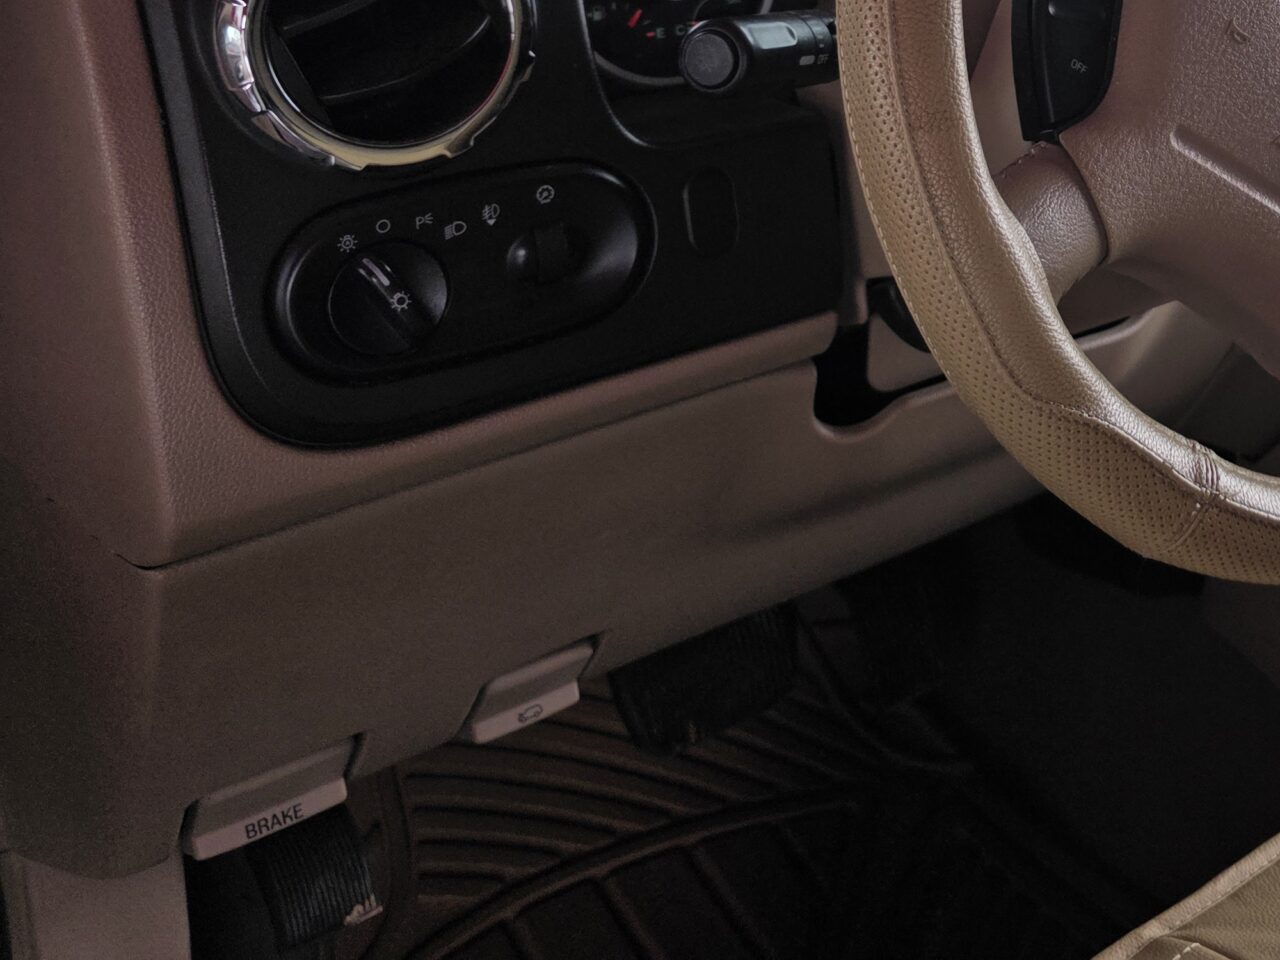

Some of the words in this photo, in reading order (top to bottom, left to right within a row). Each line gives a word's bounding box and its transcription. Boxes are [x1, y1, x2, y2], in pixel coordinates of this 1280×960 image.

[656, 28, 667, 39] E
[675, 26, 687, 37] C
[1070, 58, 1088, 75] OFF
[244, 802, 305, 840] BRAKE
